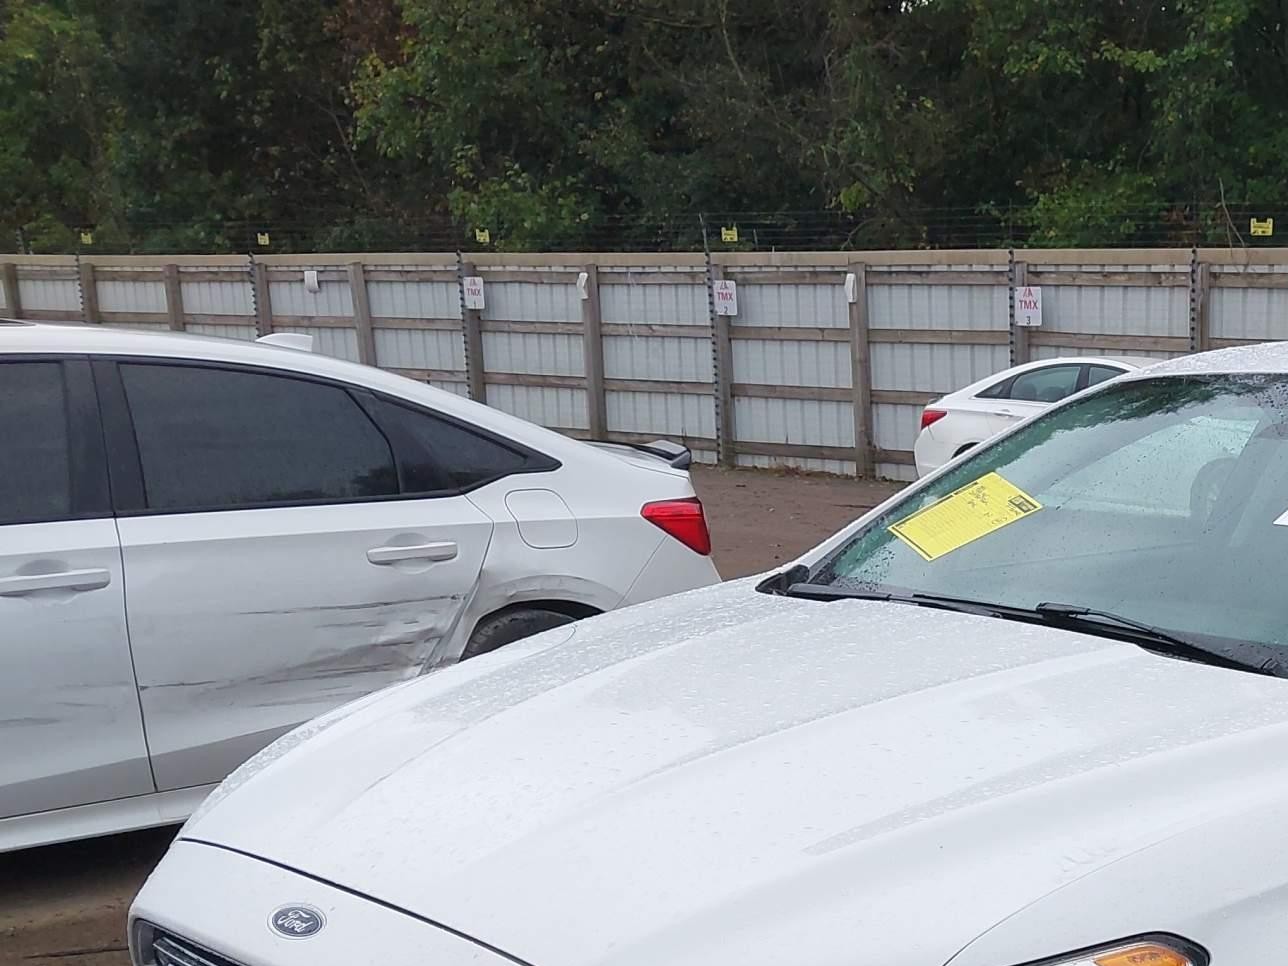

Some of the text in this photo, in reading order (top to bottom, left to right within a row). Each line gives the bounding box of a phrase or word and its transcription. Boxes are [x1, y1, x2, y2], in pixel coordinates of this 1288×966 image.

[466, 287, 482, 297] TMX
[717, 291, 734, 302] TMX
[1018, 299, 1039, 311] TMX
[1025, 315, 1031, 325] 3
[276, 909, 314, 933] Ford
